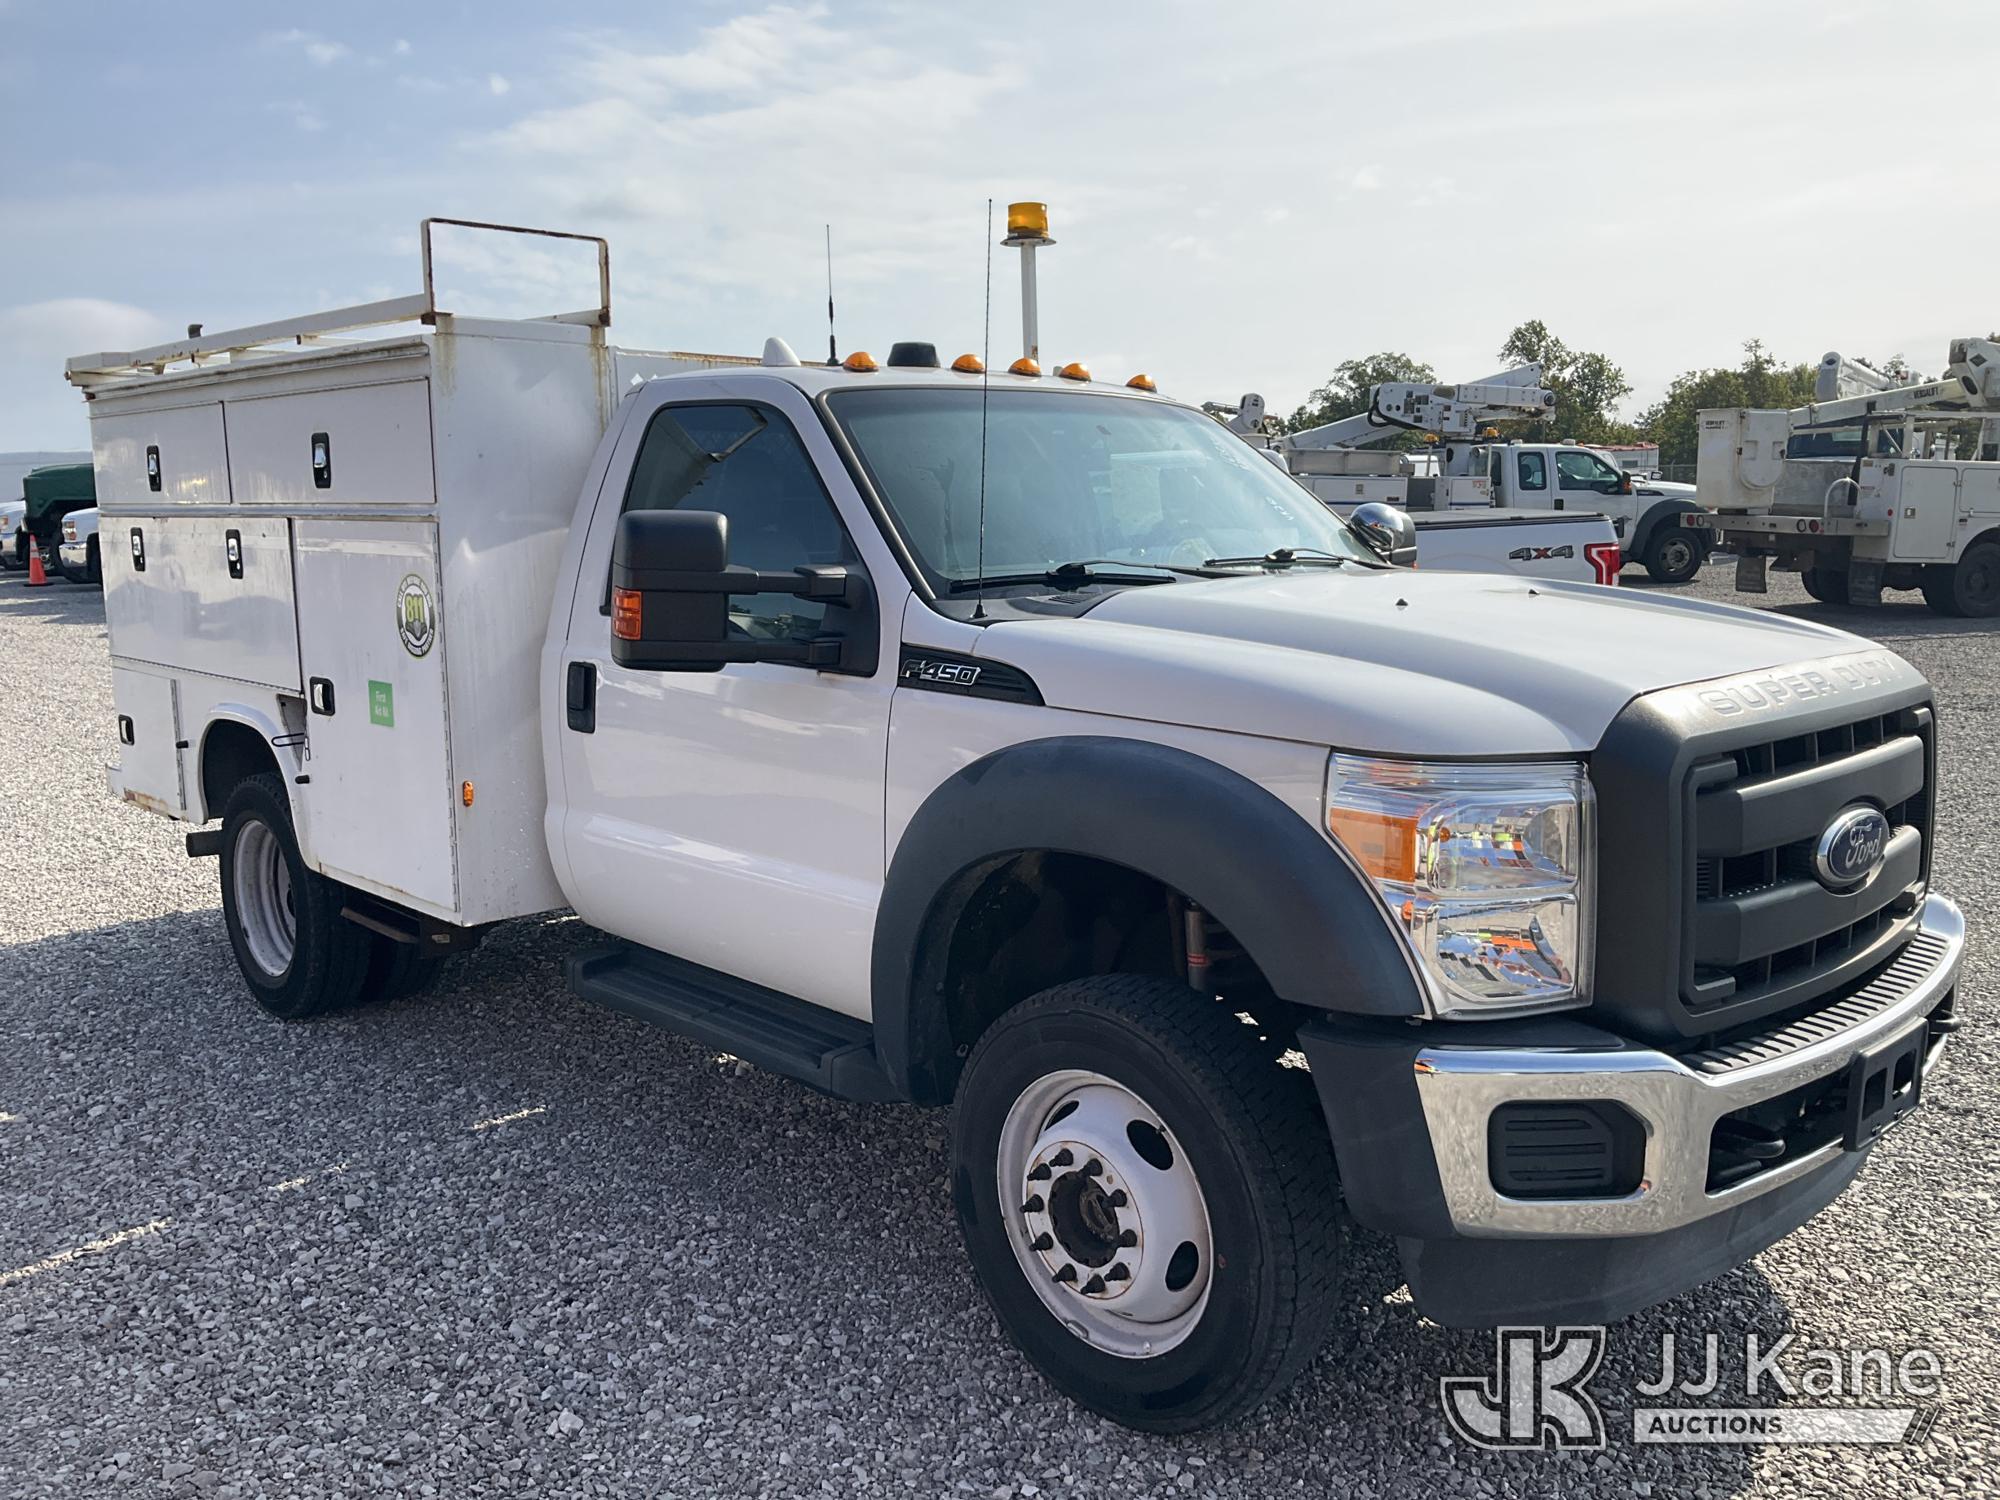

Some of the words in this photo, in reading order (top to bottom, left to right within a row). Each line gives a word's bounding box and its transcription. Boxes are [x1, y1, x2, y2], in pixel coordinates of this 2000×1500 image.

[405, 594, 424, 623] 811
[1699, 671, 1839, 717] SUPER
[1832, 657, 1902, 691] DUTY
[1845, 822, 1882, 869] Ford
